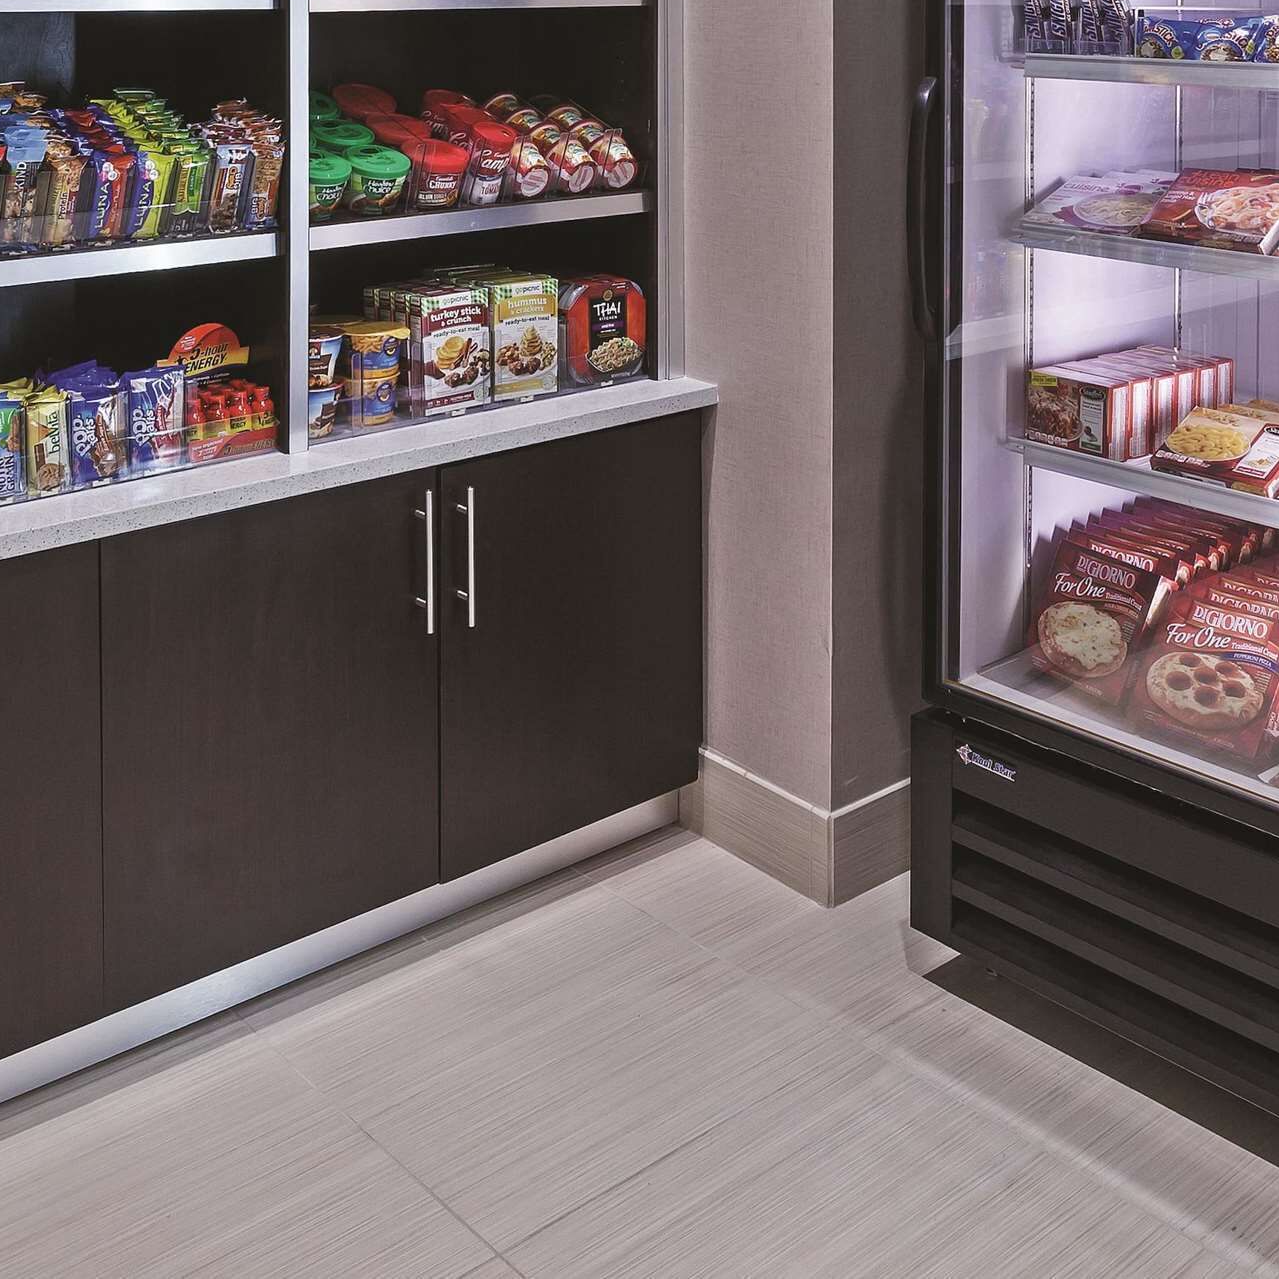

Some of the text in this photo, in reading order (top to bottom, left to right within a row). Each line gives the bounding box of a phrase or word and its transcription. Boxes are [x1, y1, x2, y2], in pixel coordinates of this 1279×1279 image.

[16, 161, 27, 193] KIND
[1064, 181, 1110, 193] cuisine
[58, 192, 69, 220] Protein
[95, 181, 111, 228] LUNA
[134, 181, 153, 226] LUNA
[430, 305, 481, 323] turkey stick
[507, 297, 548, 309] hummus
[592, 301, 622, 318] THAI
[446, 315, 472, 326] crunch
[505, 316, 538, 326] ready-to-eat
[433, 325, 481, 339] ready-to-eat meal
[184, 352, 227, 374] ENERGY
[189, 343, 229, 361] 5-hour
[48, 410, 61, 456] belVita
[4, 454, 16, 493] GRAIN
[1053, 572, 1106, 598] For One
[1166, 622, 1232, 649] For One
[1231, 642, 1264, 655] Traditional
[971, 753, 1016, 779] Kool Star
